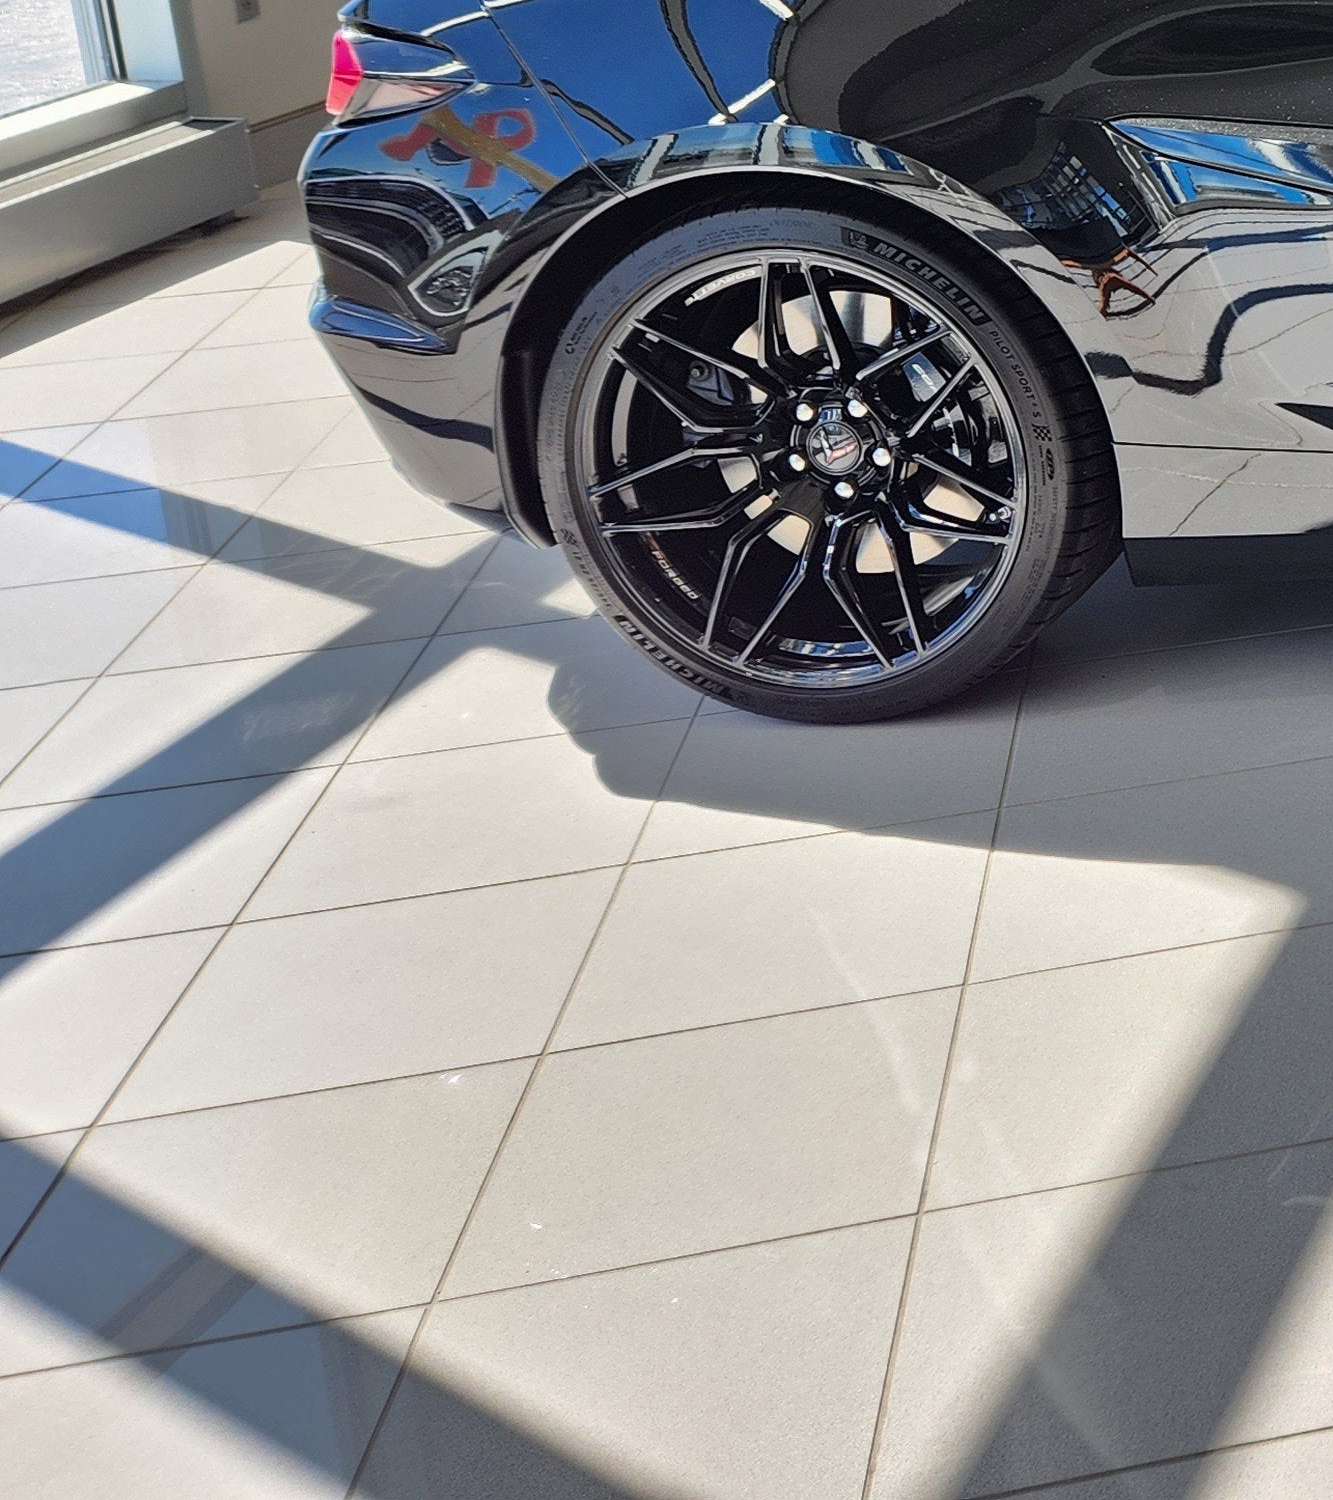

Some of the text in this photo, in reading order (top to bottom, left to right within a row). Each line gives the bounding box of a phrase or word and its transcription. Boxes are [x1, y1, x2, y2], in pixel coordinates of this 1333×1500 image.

[873, 241, 987, 323] MICHELIN
[989, 330, 1016, 361] PILOT
[1010, 363, 1037, 400] SPORT
[650, 550, 700, 600] FORGED
[617, 619, 724, 694] MICHELIN
